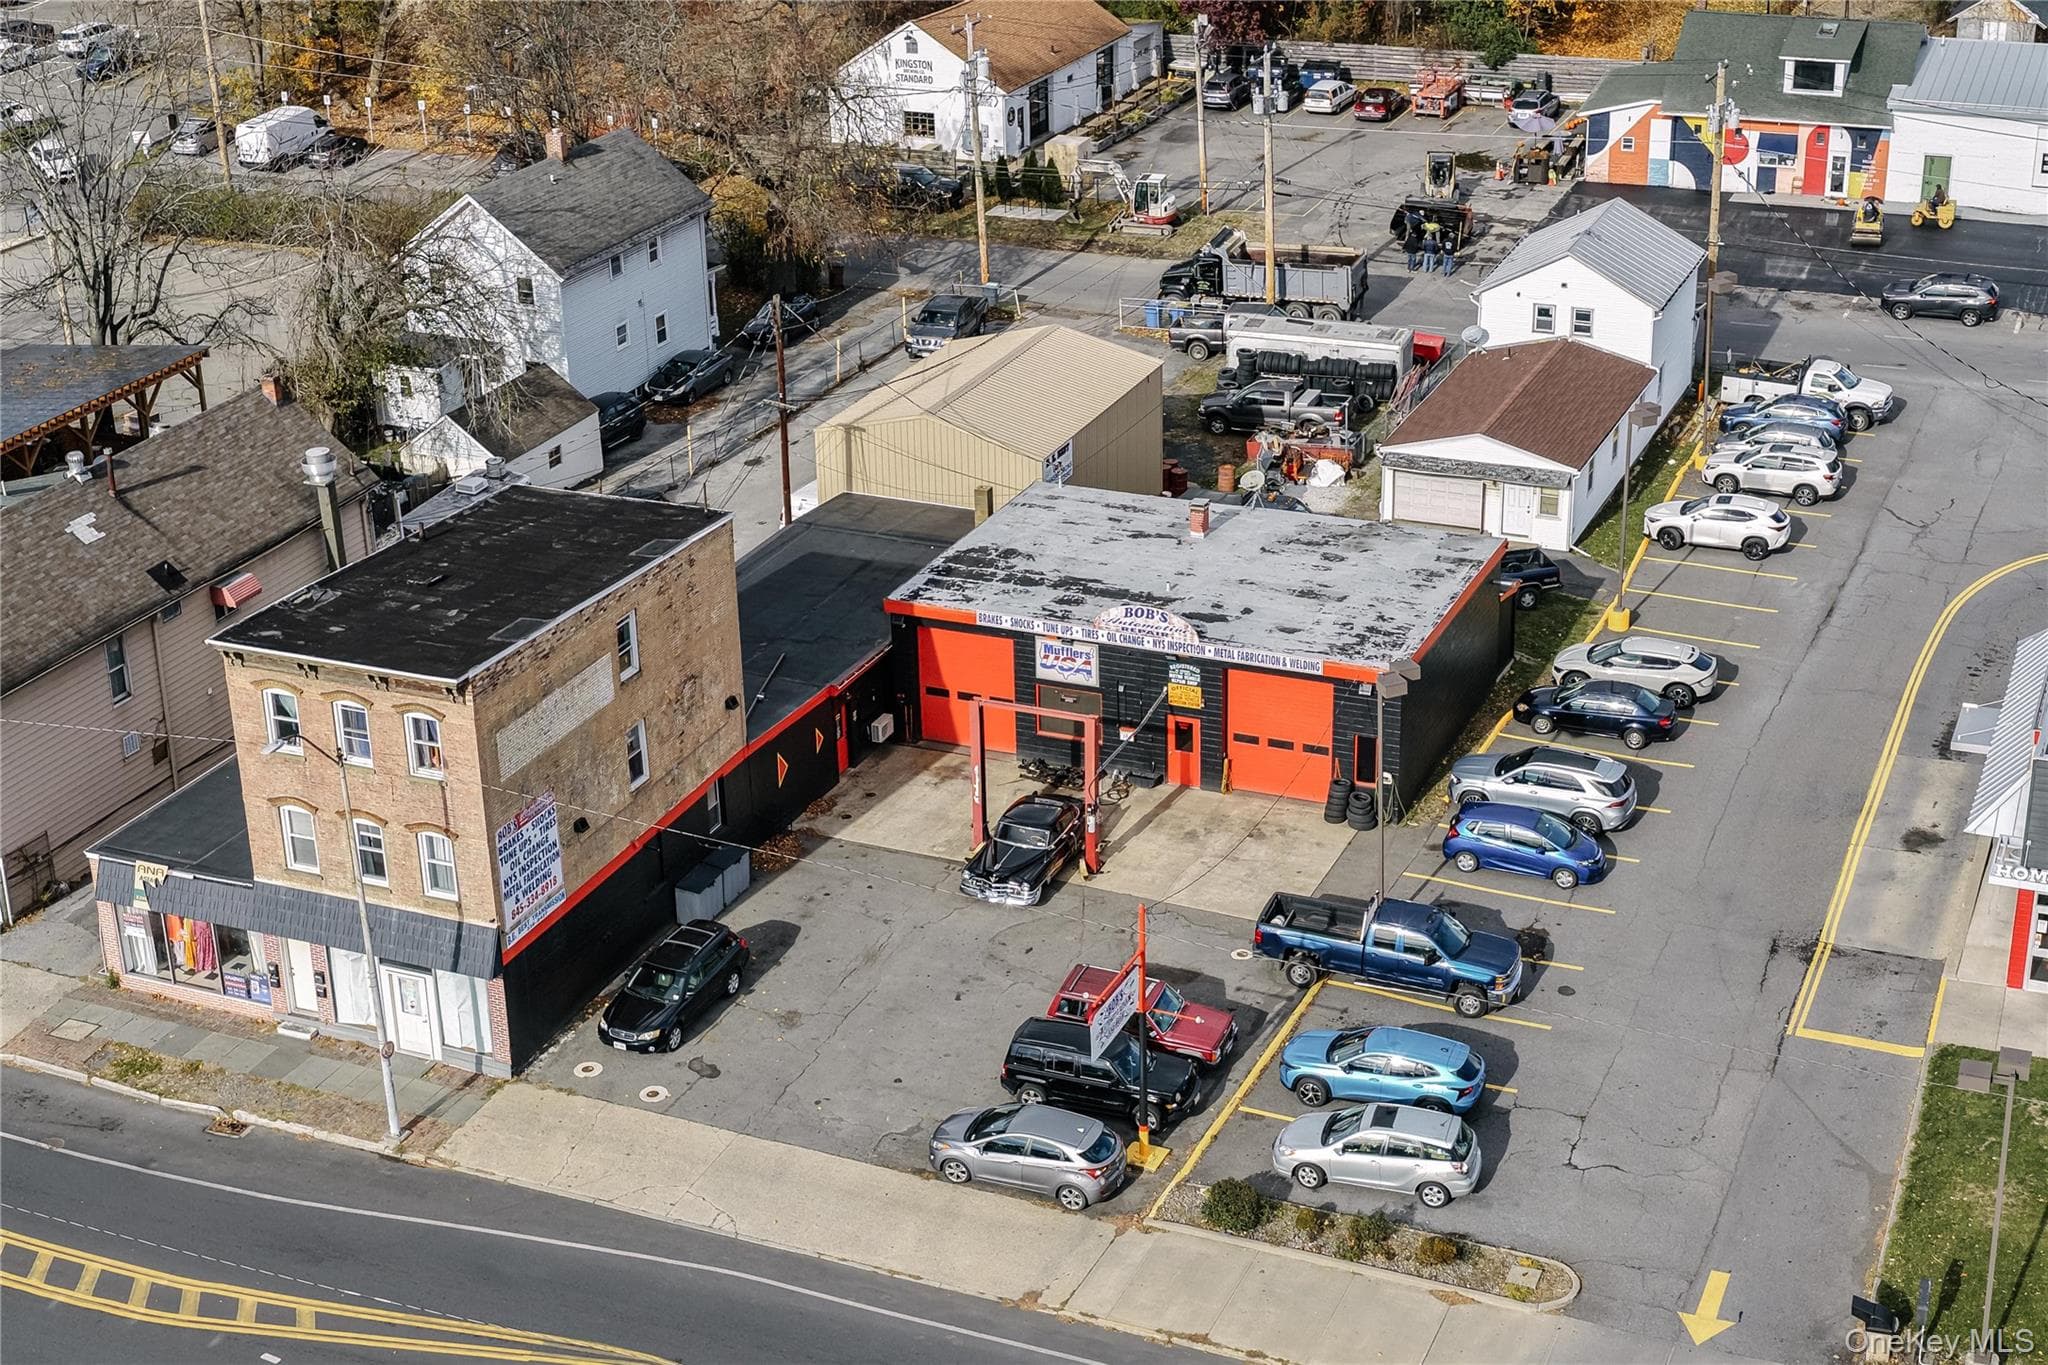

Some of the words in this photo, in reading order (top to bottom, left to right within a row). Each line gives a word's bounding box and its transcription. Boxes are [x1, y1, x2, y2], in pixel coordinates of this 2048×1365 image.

[895, 58, 933, 72] KINGSTON
[895, 73, 934, 85] STANDARD
[1124, 607, 1168, 623] BOB'S
[978, 612, 1003, 626] BRAKES
[1010, 617, 1035, 630] SHOCKS
[1042, 622, 1059, 634] TUNE
[1060, 625, 1074, 636] UPS
[1081, 628, 1099, 640] TIRES
[1106, 631, 1118, 643] OIL
[1119, 633, 1145, 647] CHANGE
[1152, 638, 1166, 650] NYS
[1167, 640, 1206, 656] INSPECTION
[1213, 647, 1236, 660] METAL
[1237, 650, 1281, 667] FABRICATION
[1281, 658, 1288, 667] &
[1289, 658, 1321, 672] WELDING
[1121, 626, 1169, 638] REPAIR
[1043, 643, 1092, 660] Mufflers
[1040, 654, 1093, 679] USA
[1171, 685, 1199, 695] OFFICIAL
[497, 819, 518, 844] BOB'S
[498, 829, 525, 857] BRAKES
[531, 805, 556, 831] SHOCKS
[500, 846, 517, 868] TUNE
[519, 835, 532, 853] UPS
[539, 816, 557, 837] TIRES
[504, 871, 518, 889] NYS
[519, 839, 558, 877] INSPECTION
[510, 856, 522, 871] OIL
[523, 833, 550, 860] CHANGE
[137, 864, 165, 877] ANA
[504, 881, 523, 901] METAL
[523, 848, 561, 885] FABRICATION
[1995, 864, 2048, 884] HOM
[511, 875, 558, 920] 845-334-8918
[515, 893, 521, 905] &
[522, 867, 553, 898] WELDING
